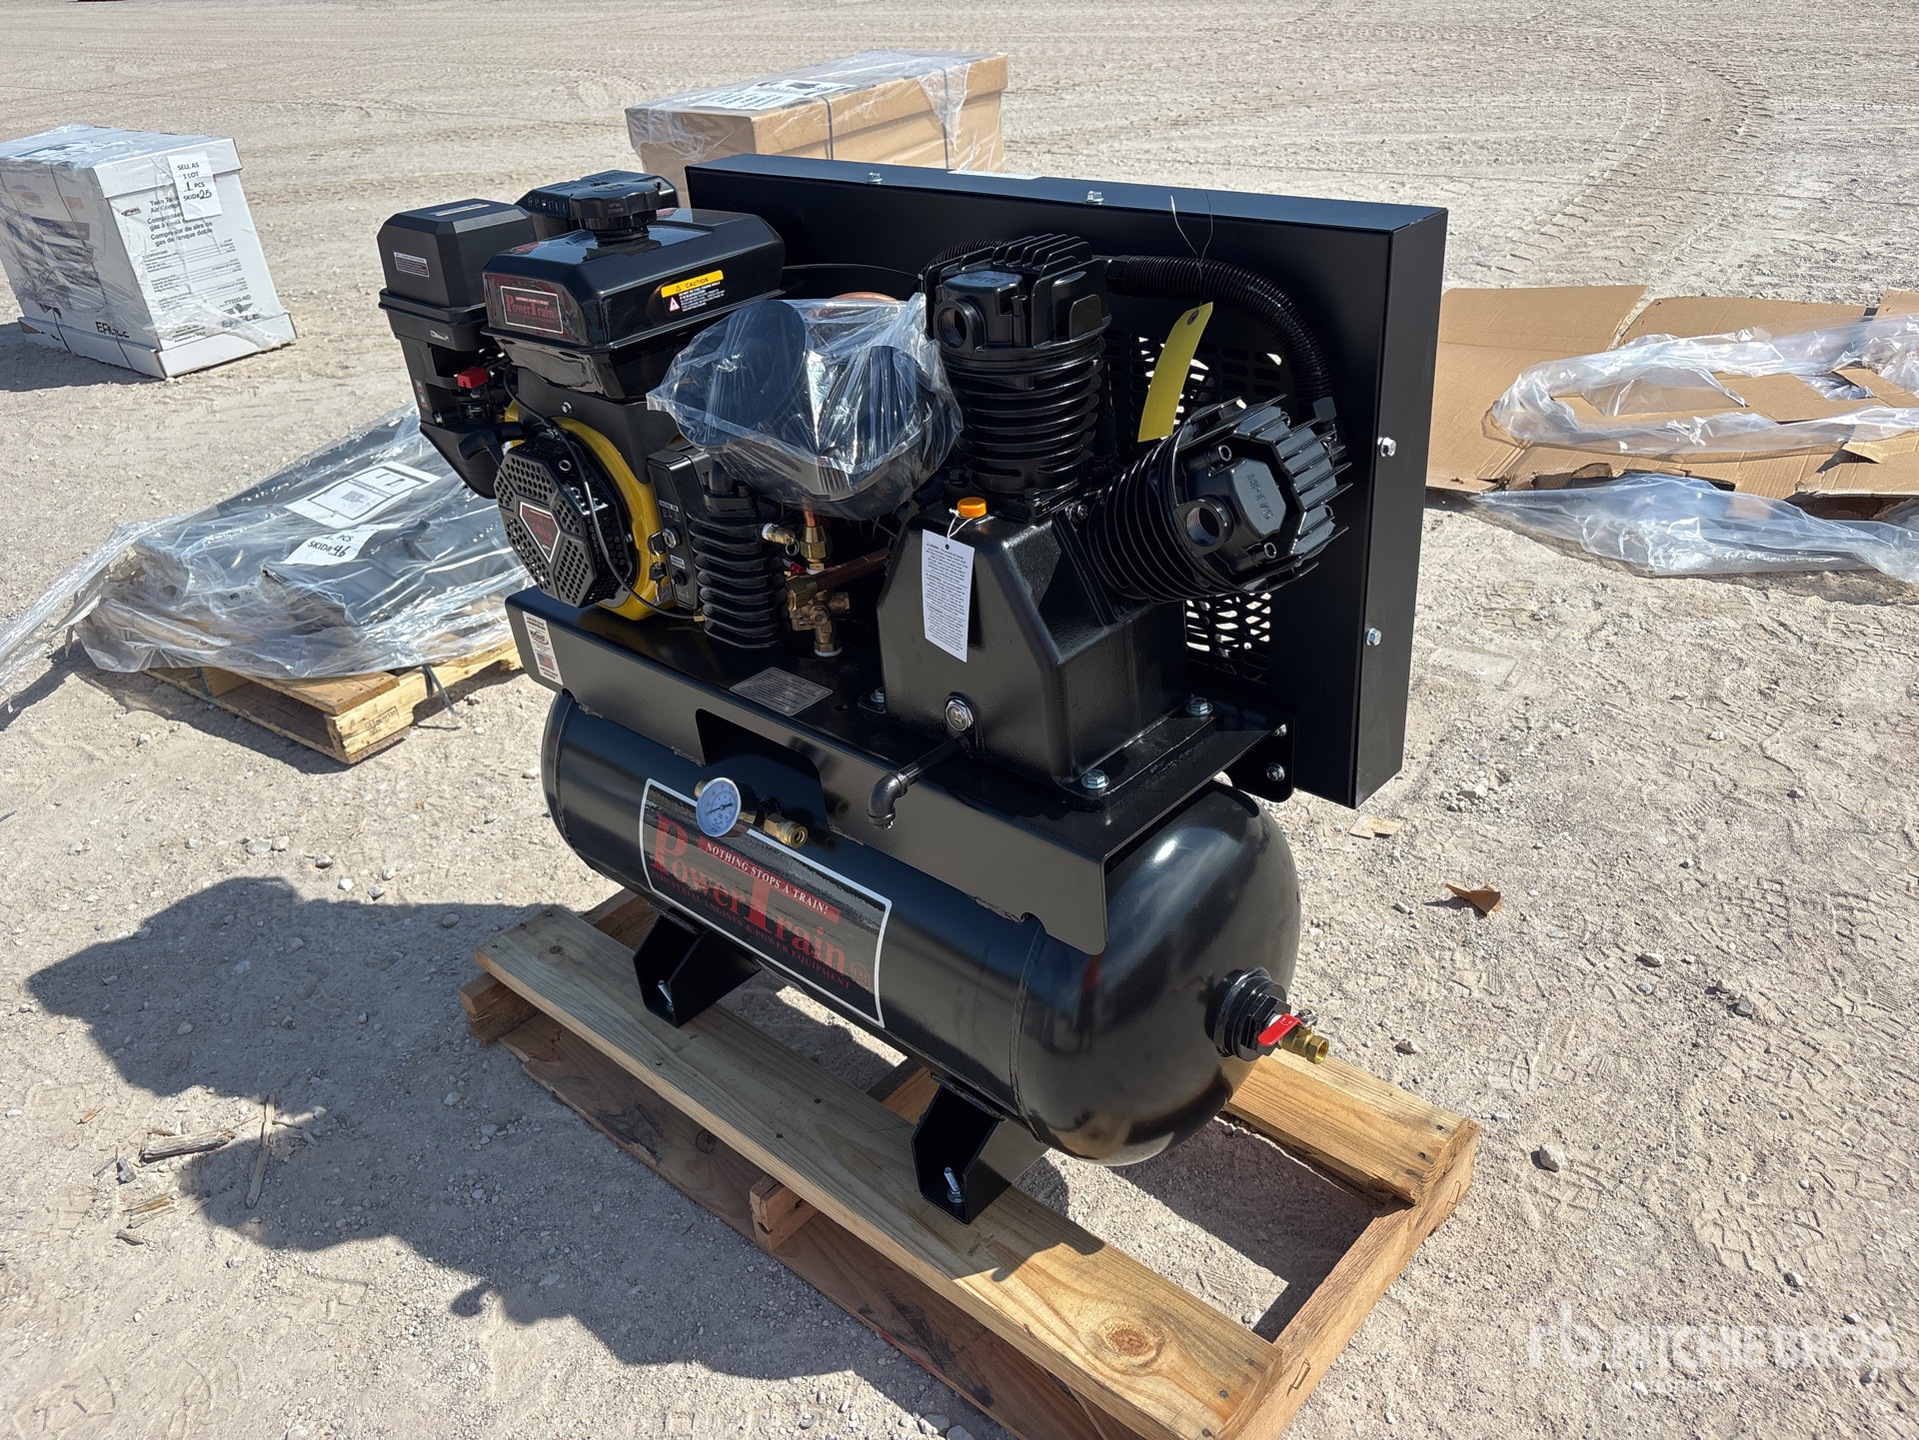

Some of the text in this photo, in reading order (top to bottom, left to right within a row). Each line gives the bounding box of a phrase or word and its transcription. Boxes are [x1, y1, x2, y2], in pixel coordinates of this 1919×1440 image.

[177, 163, 190, 171] SELL
[187, 171, 199, 179] LOT
[150, 206, 160, 214] Air
[149, 224, 161, 232] gaz
[193, 222, 205, 230] aire
[154, 239, 166, 247] gas
[196, 228, 213, 236] doble
[685, 277, 709, 289] CAUTION
[706, 842, 829, 915] NOTHING STOPS A TRAIN!
[651, 868, 700, 902] INDUSTRIAL
[704, 900, 744, 927] ENGINES
[755, 929, 789, 954] POWER
[791, 949, 851, 990] EQUIPMENT
